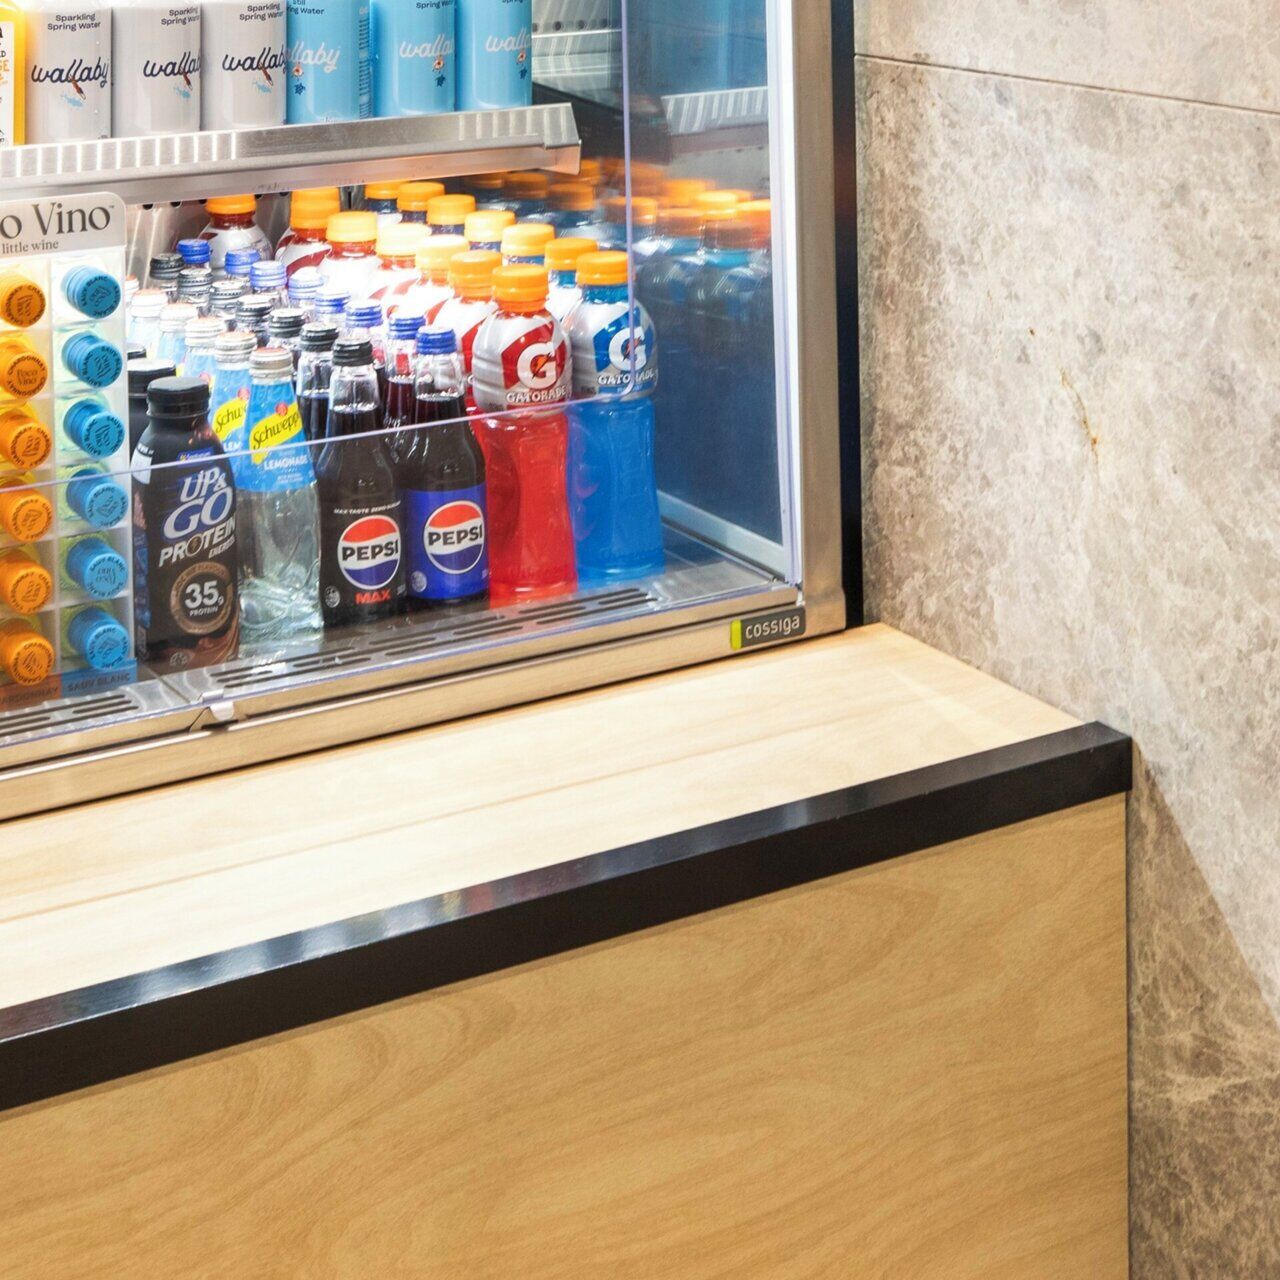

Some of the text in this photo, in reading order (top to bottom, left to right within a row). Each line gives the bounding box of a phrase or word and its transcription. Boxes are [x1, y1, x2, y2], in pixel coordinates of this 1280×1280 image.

[247, 2, 281, 12] Sparkling
[300, 7, 325, 16] Water
[416, 1, 440, 9] Spring
[55, 13, 96, 22] Sparkling
[161, 17, 187, 26] Spring
[239, 11, 266, 21] Spring
[47, 21, 101, 32] Spring Water
[31, 57, 109, 89] wallaby
[32, 202, 112, 236] Vino
[2, 242, 29, 255] little
[30, 239, 59, 252] wine
[608, 327, 648, 371] G
[517, 342, 557, 389] G
[506, 385, 567, 403] GATORADE
[264, 455, 308, 470] LEMONADE
[163, 486, 234, 539] GO
[159, 512, 236, 568] PROTEIN
[428, 525, 483, 546] PEPSI
[342, 539, 399, 561] PEPSI
[355, 590, 391, 604] MAX
[189, 606, 218, 618] PROTEIN
[745, 616, 800, 639] cossiga
[68, 672, 131, 692] SAUV BLANC
